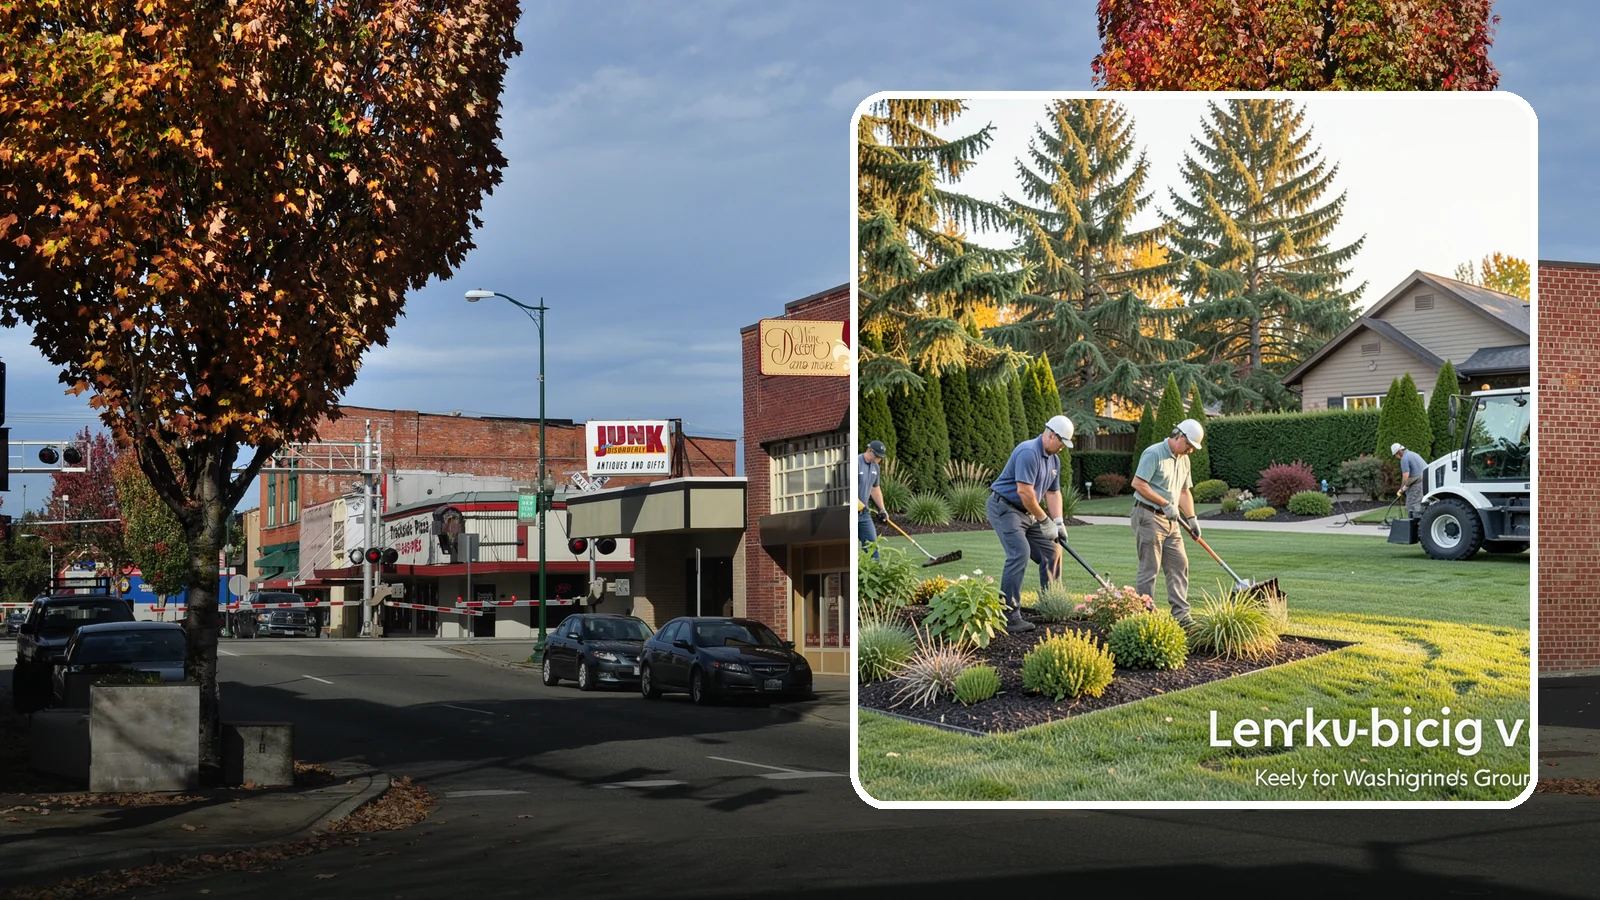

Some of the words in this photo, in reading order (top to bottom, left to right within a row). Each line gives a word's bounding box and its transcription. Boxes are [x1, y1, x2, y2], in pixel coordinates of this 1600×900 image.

[765, 328, 830, 365] Decor
[596, 426, 664, 457] JUNK
[607, 446, 646, 454] DISORDERLY
[597, 462, 628, 470] ANTIQUES
[631, 461, 644, 470] AND
[646, 461, 665, 469] GIFTS
[390, 520, 413, 539] Trackside
[414, 519, 429, 535] Pizza
